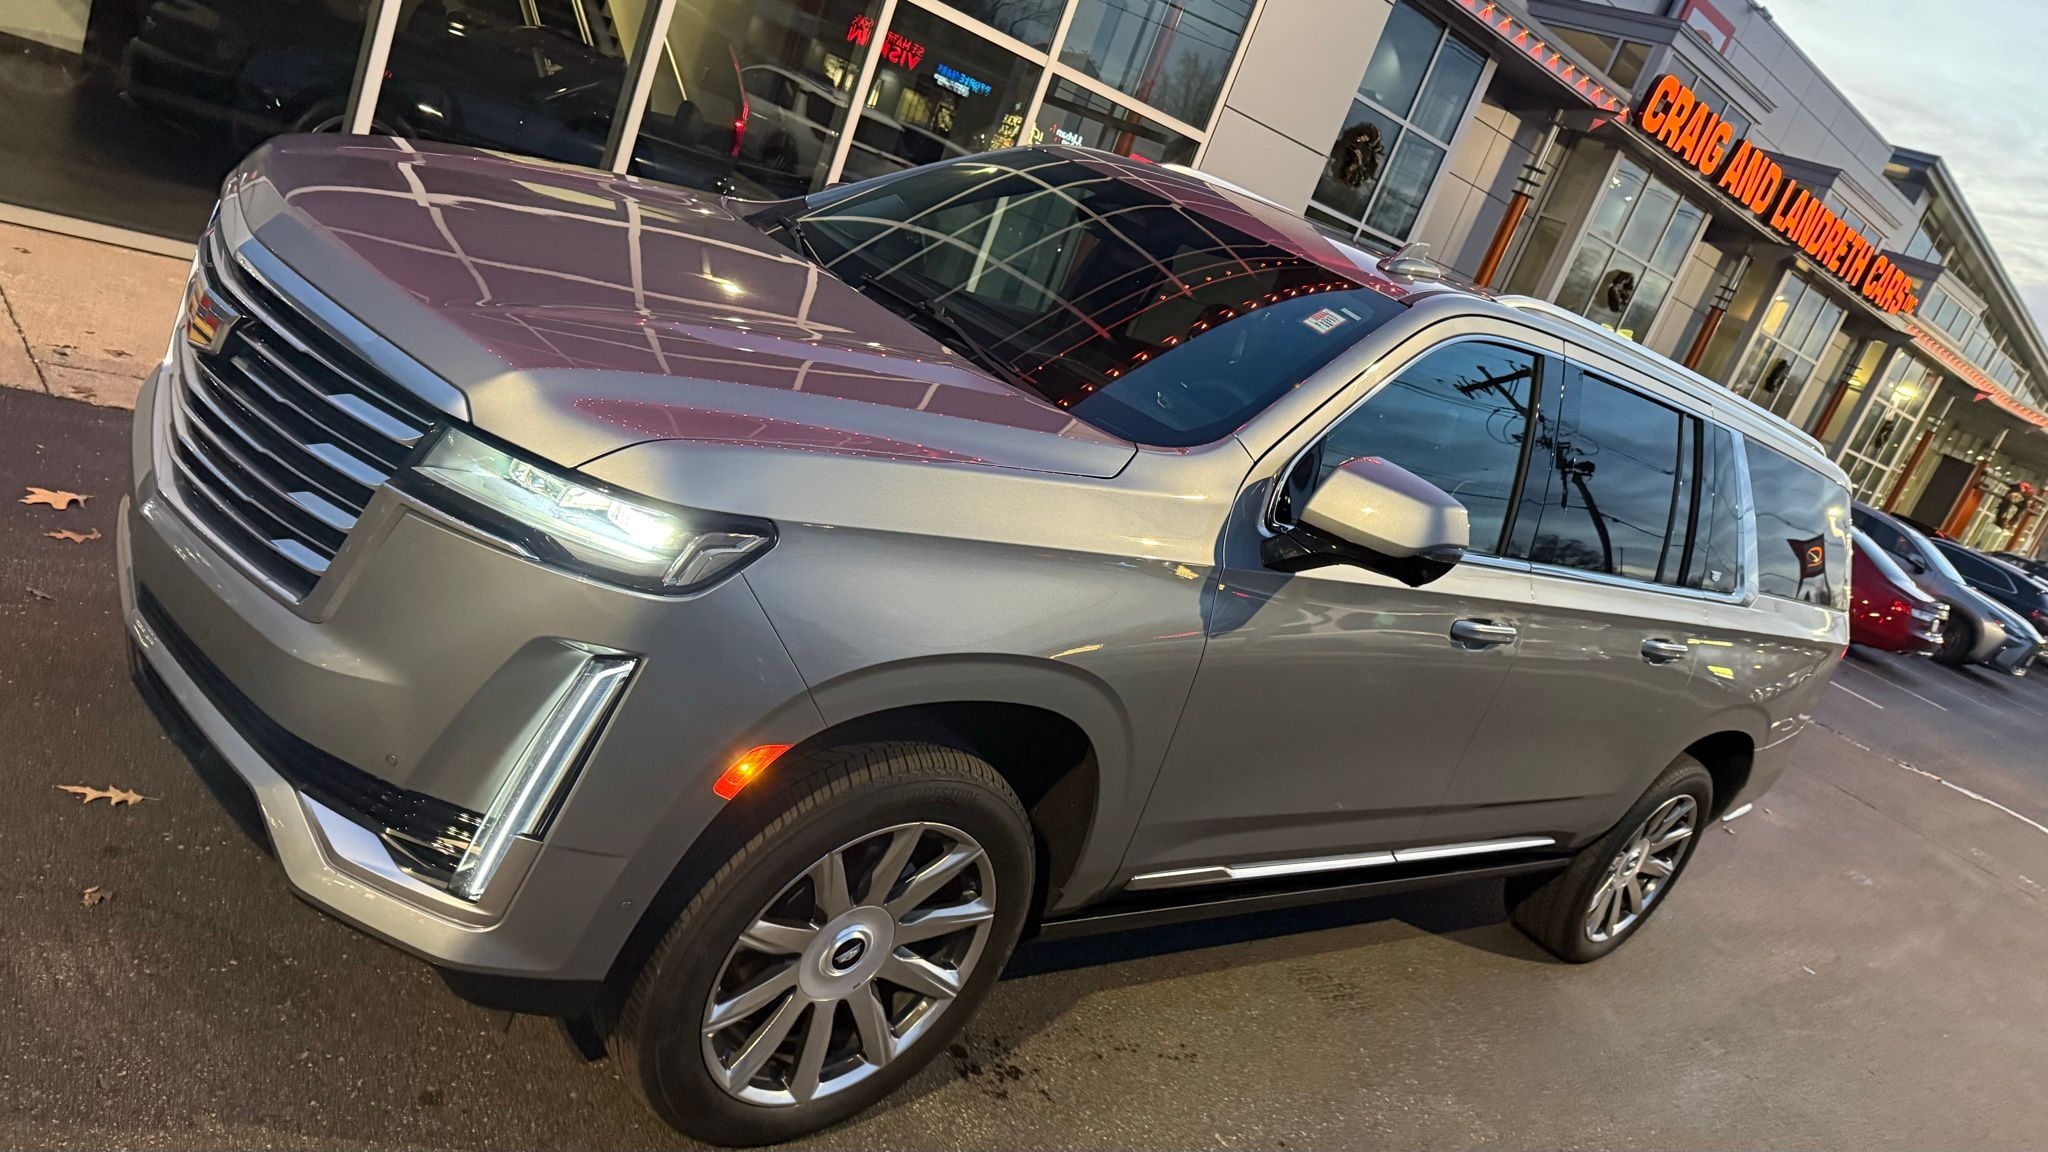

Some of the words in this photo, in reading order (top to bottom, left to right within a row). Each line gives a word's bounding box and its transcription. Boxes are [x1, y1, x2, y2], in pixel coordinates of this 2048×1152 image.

[1642, 74, 1733, 176] CRAIG
[1719, 140, 1783, 214] AND
[1770, 179, 1875, 286] LANDRETH
[1862, 255, 1912, 315] CARS
